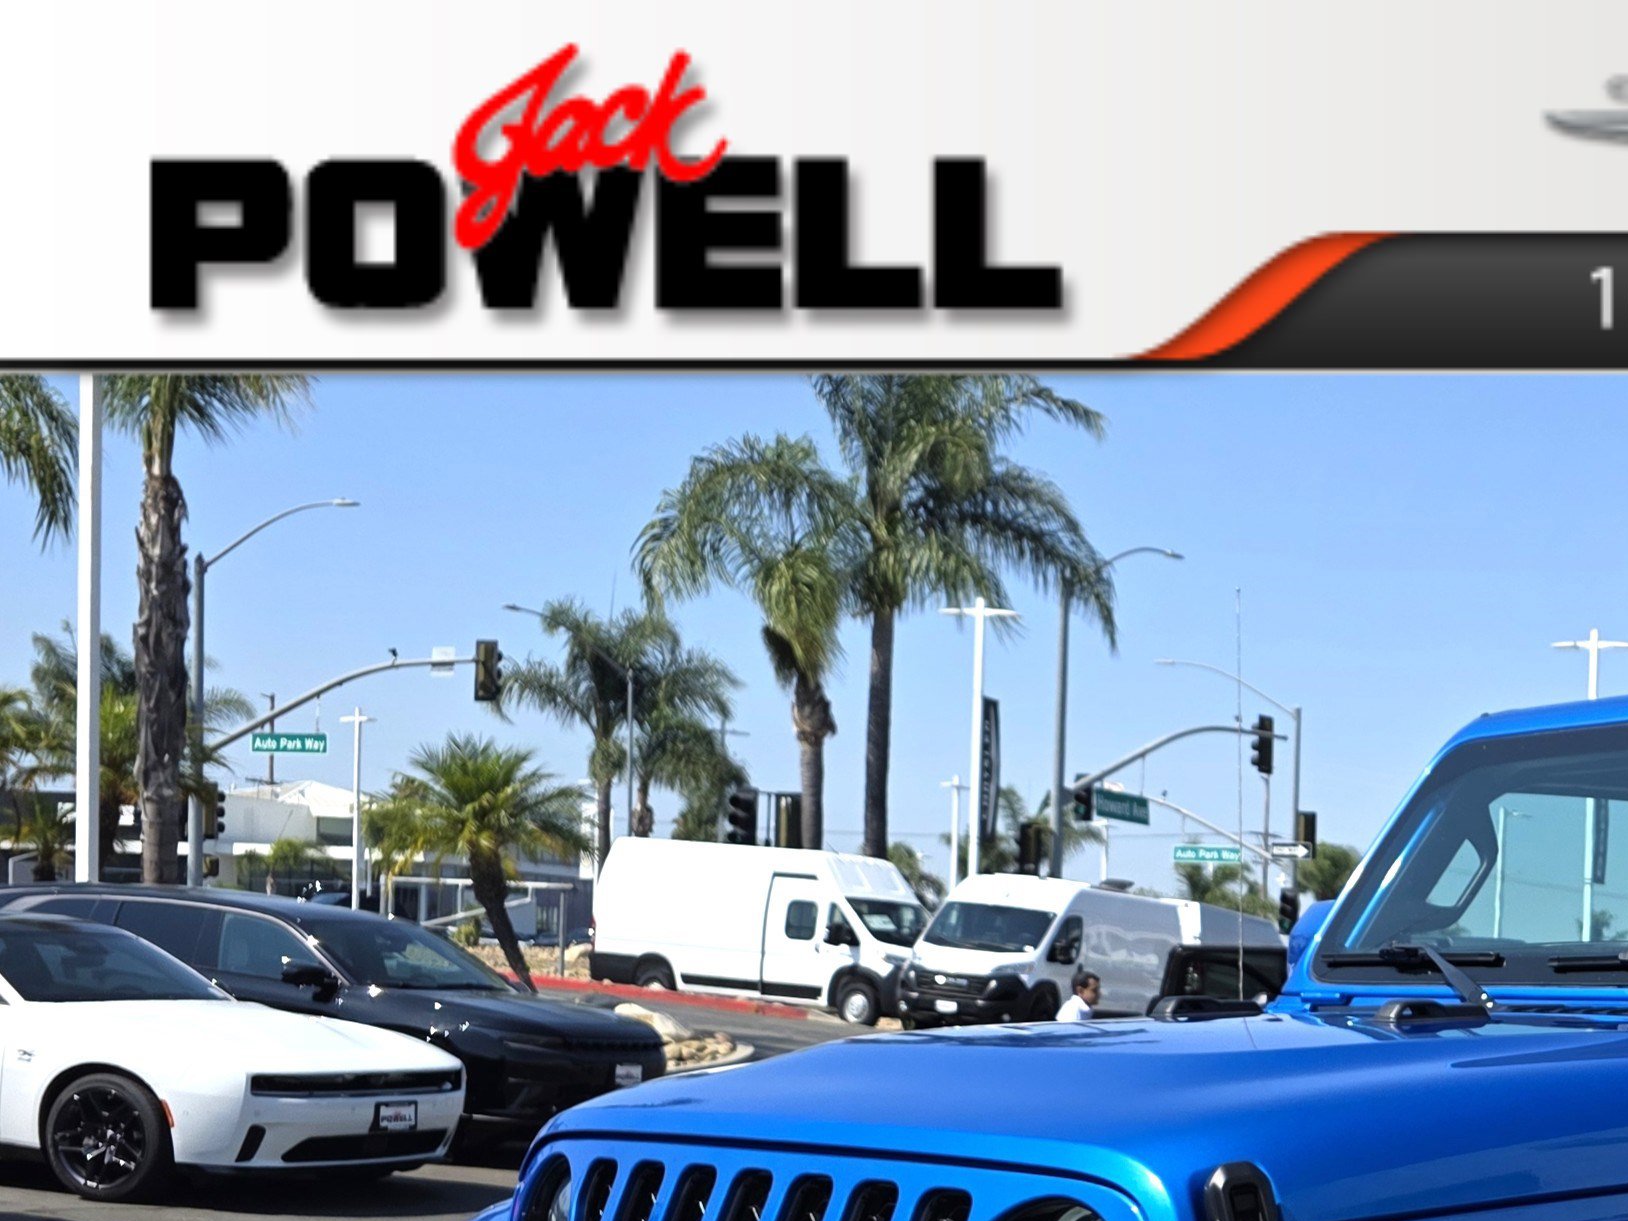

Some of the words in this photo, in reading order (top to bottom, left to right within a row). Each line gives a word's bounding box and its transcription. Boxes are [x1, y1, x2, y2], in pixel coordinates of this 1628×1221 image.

[254, 736, 277, 750] Auto
[280, 737, 302, 750] Park
[305, 737, 325, 753] Way
[1176, 849, 1196, 859] Auto
[1199, 849, 1219, 859] Park
[1222, 850, 1241, 861] Way
